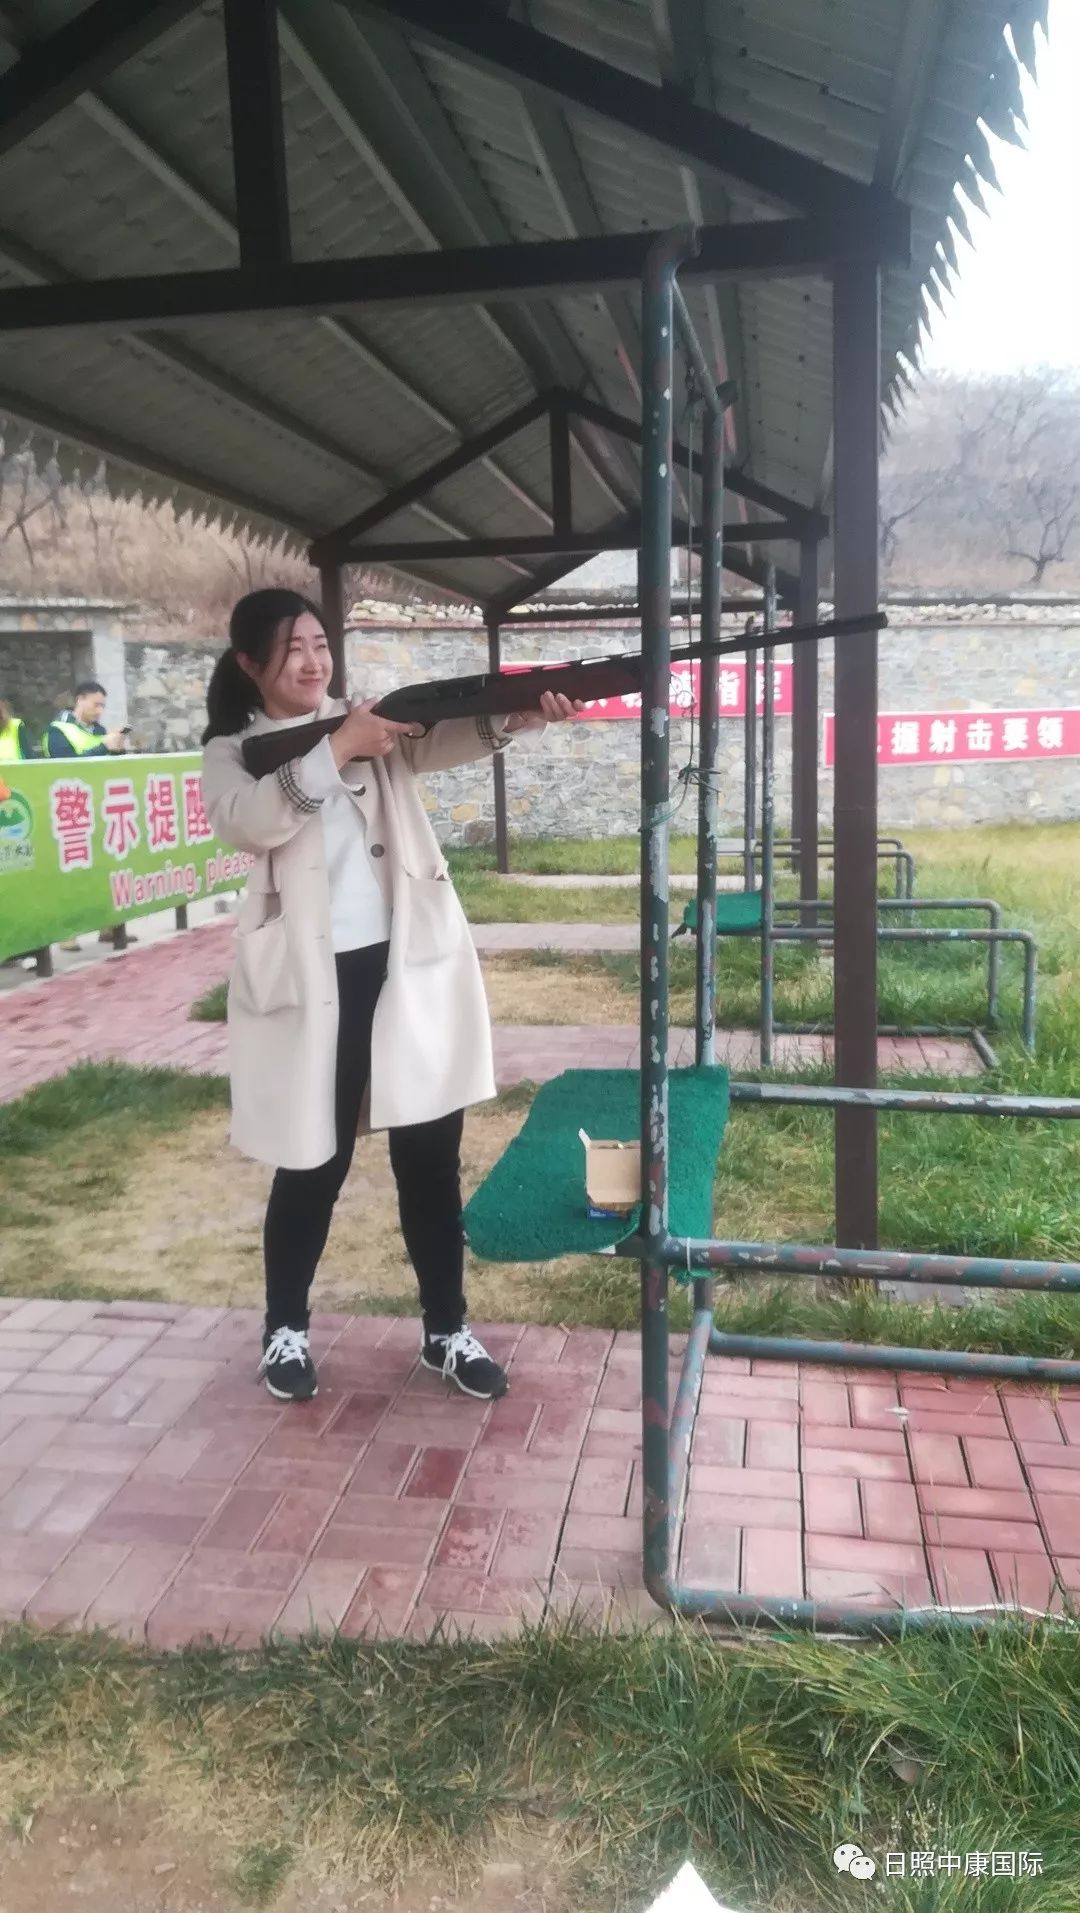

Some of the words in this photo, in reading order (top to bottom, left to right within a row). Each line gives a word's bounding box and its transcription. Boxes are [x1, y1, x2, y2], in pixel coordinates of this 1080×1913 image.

[877, 716, 1064, 755] 握射击要领
[53, 774, 212, 867] 警示提醒
[112, 861, 202, 909] Warning,
